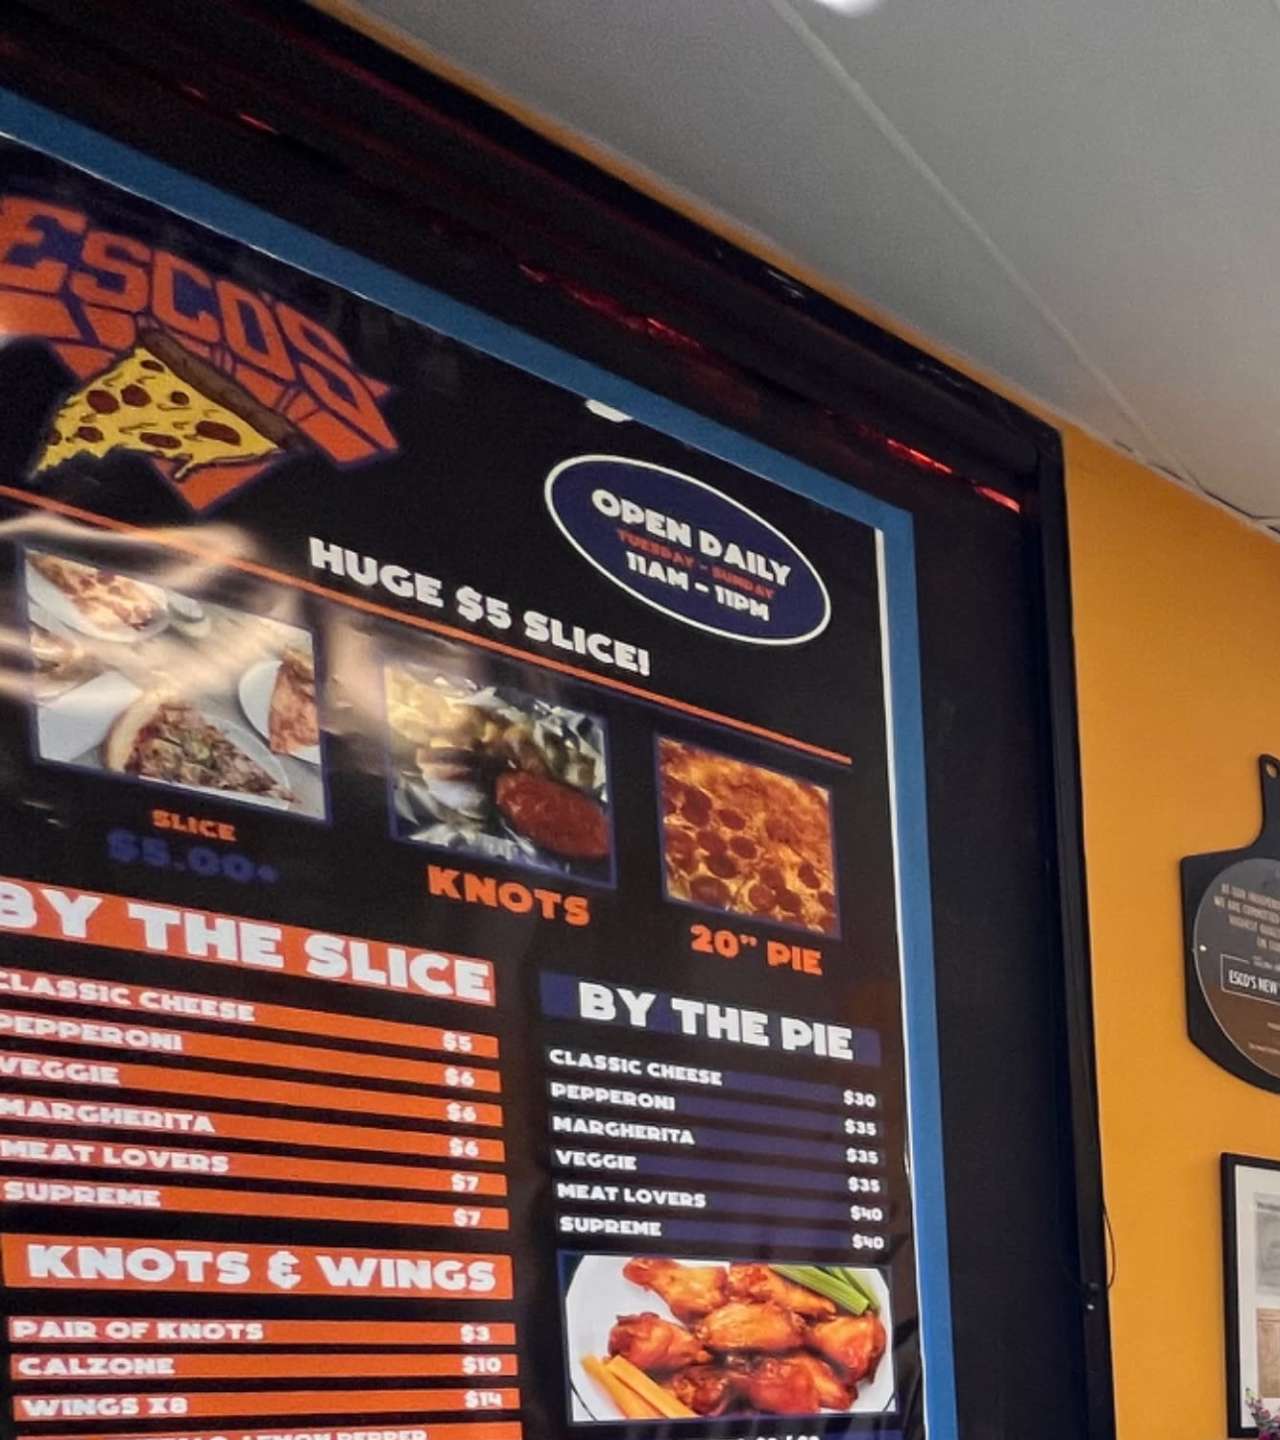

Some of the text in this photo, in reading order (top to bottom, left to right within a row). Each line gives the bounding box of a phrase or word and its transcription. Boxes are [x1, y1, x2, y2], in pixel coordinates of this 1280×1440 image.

[592, 489, 791, 586] OPEN DAILY
[617, 528, 694, 569] TUESDAY
[711, 564, 775, 599] SUNDAY
[309, 537, 651, 676] HUGE $5 SLICE!
[626, 551, 689, 591] 11AM
[715, 584, 769, 622] 11PM
[153, 809, 237, 842] SLICE
[427, 864, 590, 928] KNOTS
[0, 881, 491, 1003] BY THE SLICE
[766, 940, 823, 976] PIE
[1258, 978, 1278, 995] NEW
[140, 988, 256, 1024] CHEESE
[443, 1030, 473, 1054] $5
[579, 981, 853, 1060] BY THE PIE
[0, 1013, 475, 1088] PEPPERONI $6
[0, 1055, 477, 1124] VEGGIE $6
[549, 1049, 876, 1108] CLASSIC CHEESE $30
[0, 1098, 479, 1158] MARGHERITA $6
[550, 1082, 877, 1136] PEPPERONI $35
[2, 1140, 480, 1194] MEAT LOVERS $7
[553, 1116, 879, 1165] MARGHERITA $35
[556, 1150, 881, 1193] VEGGIE $35
[4, 1179, 482, 1228] SUPREME $7
[557, 1183, 883, 1222] MEAT LOVERS $40
[559, 1216, 885, 1250] SUPREME $40
[27, 1244, 496, 1292] KNOTS & WINGS
[13, 1320, 490, 1344] PAIR OF KNOTS $3
[17, 1355, 502, 1376] CALZONE $10
[22, 1389, 503, 1418] WINGS X8 $14
